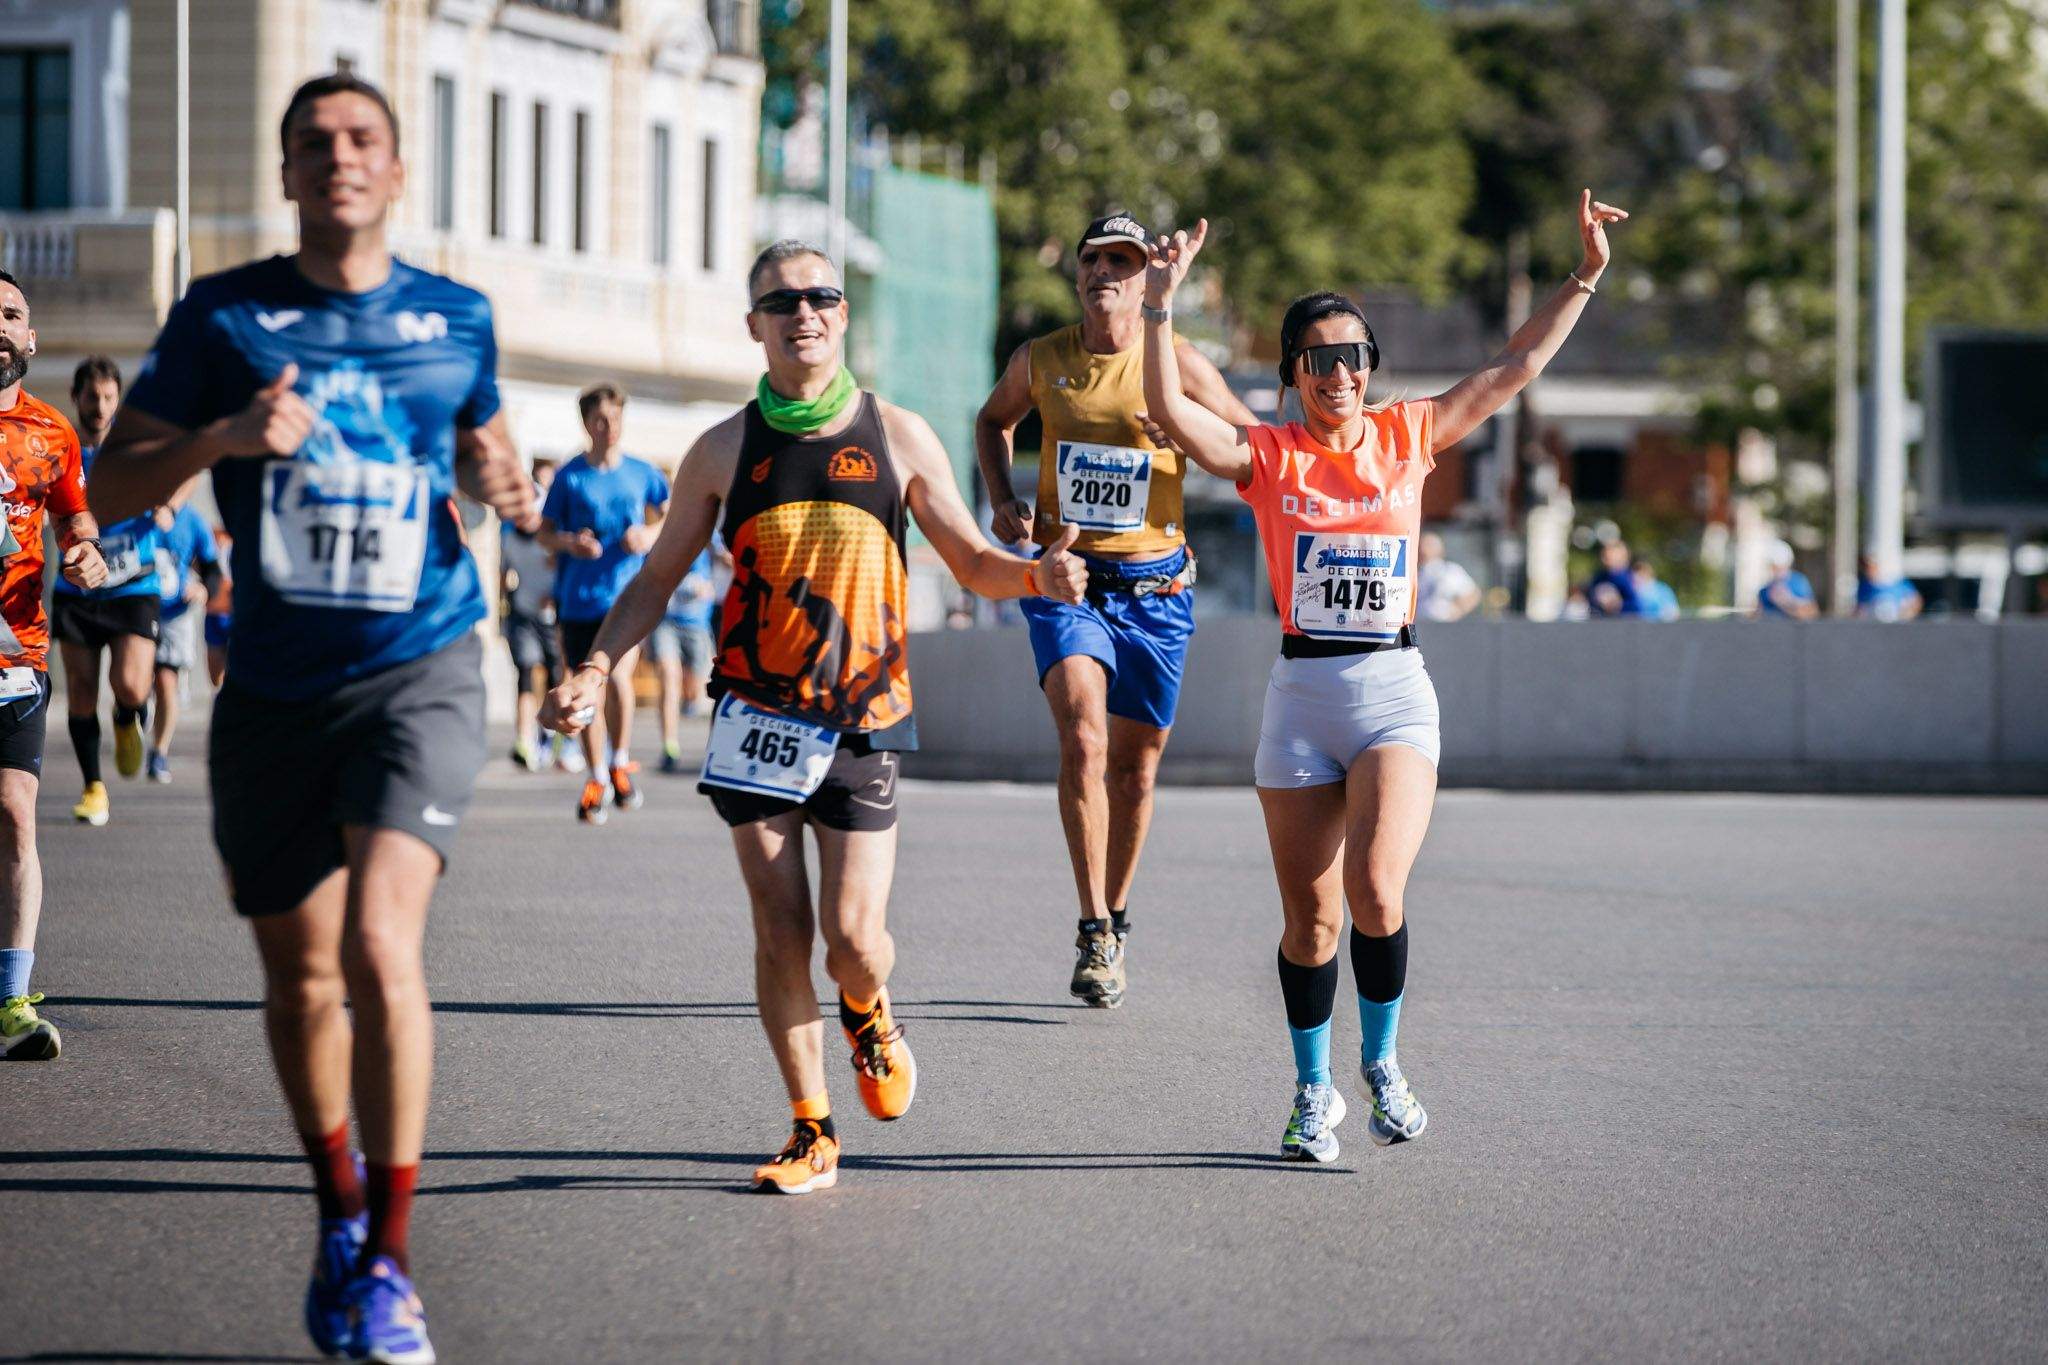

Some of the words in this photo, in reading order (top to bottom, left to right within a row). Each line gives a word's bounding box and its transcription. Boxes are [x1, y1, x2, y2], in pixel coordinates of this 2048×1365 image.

[1080, 469, 1130, 481] DECIMAS
[1071, 479, 1131, 507] 2020
[1281, 483, 1416, 517] DECIMAS
[306, 524, 381, 563] 1714
[1328, 566, 1388, 577] DECIMAS
[1319, 578, 1386, 611] 1479
[749, 715, 811, 738] DECIMAS
[739, 728, 802, 768] 465
